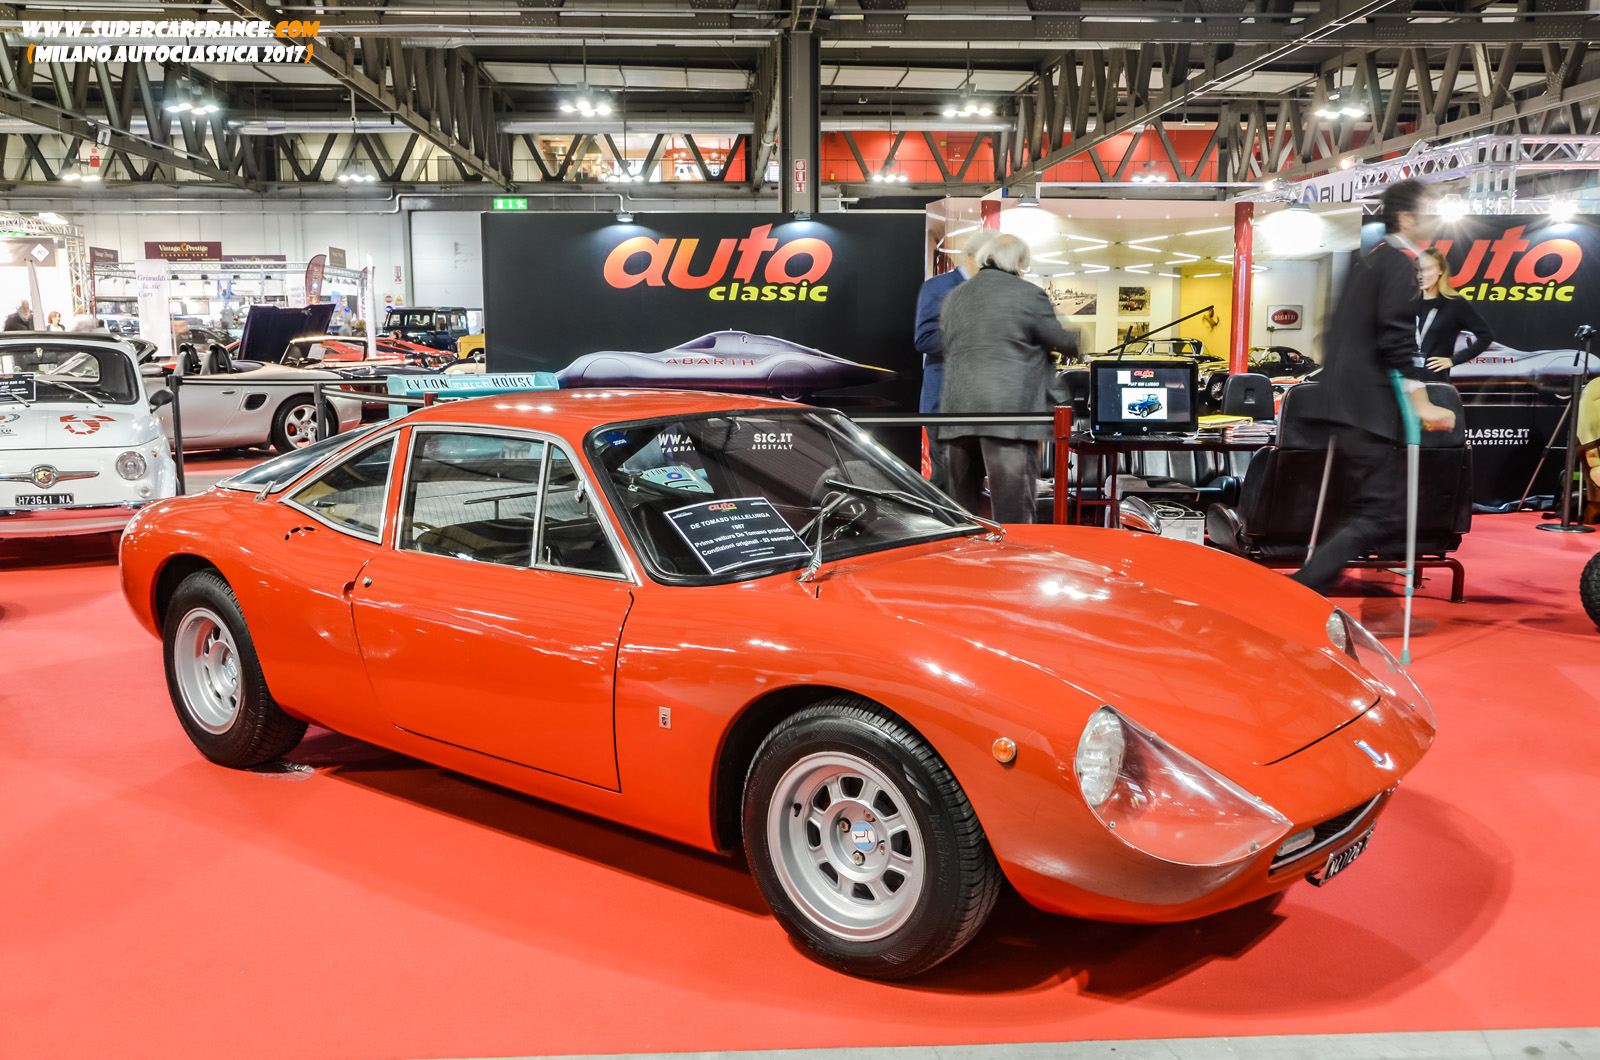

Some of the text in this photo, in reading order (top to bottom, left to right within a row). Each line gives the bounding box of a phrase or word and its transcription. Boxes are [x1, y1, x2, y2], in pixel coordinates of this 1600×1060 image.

[603, 223, 833, 289] auto
[708, 281, 829, 302] classic
[1458, 281, 1575, 302] classic
[665, 358, 754, 366] ABARTH
[451, 380, 490, 388] march
[491, 376, 533, 387] HOUSE
[753, 433, 793, 443] SIC.IT
[18, 495, 71, 505] H73641 NA
[700, 517, 730, 527] TOMASO
[729, 512, 771, 521] VALLELUNGA
[694, 539, 714, 548] Prima
